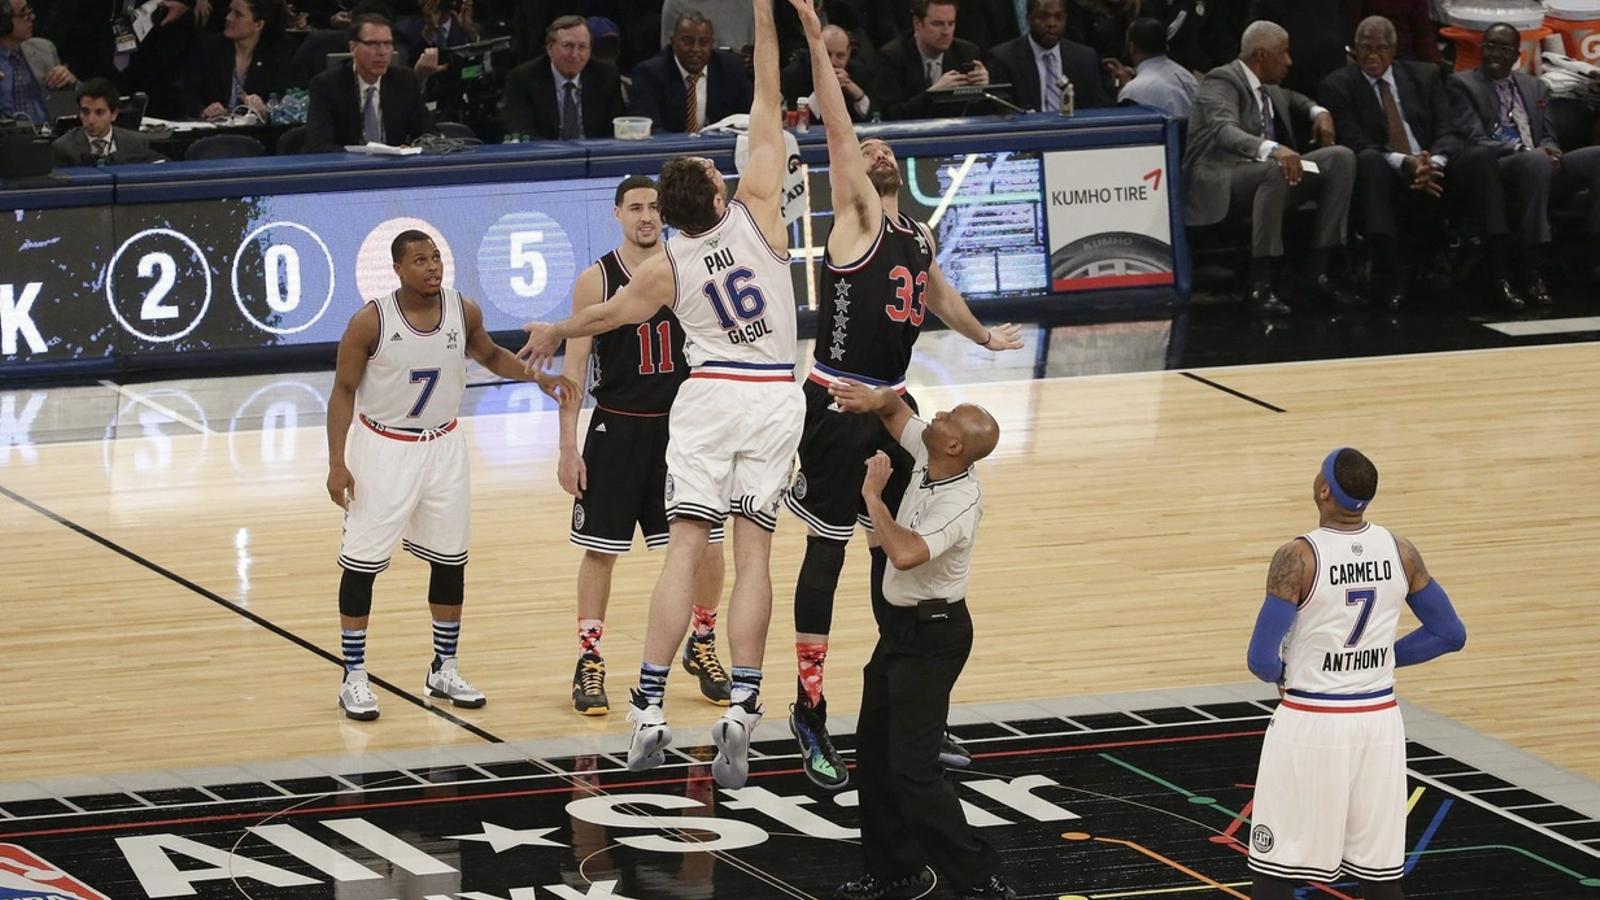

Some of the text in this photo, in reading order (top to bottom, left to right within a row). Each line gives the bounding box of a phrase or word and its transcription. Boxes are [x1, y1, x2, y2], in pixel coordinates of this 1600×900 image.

[1052, 186, 1148, 206] KUMHO TIRE
[704, 247, 735, 275] PAU
[0, 231, 547, 354] K 2 0 5
[702, 266, 767, 331] 16
[886, 265, 929, 326] 33
[637, 321, 674, 374] 11
[728, 319, 773, 344] GASOL
[406, 367, 441, 418] 7
[1329, 560, 1392, 585] CARMELO
[1343, 586, 1377, 648] 7
[1322, 647, 1388, 671] ANTHONY
[114, 817, 459, 899] All
